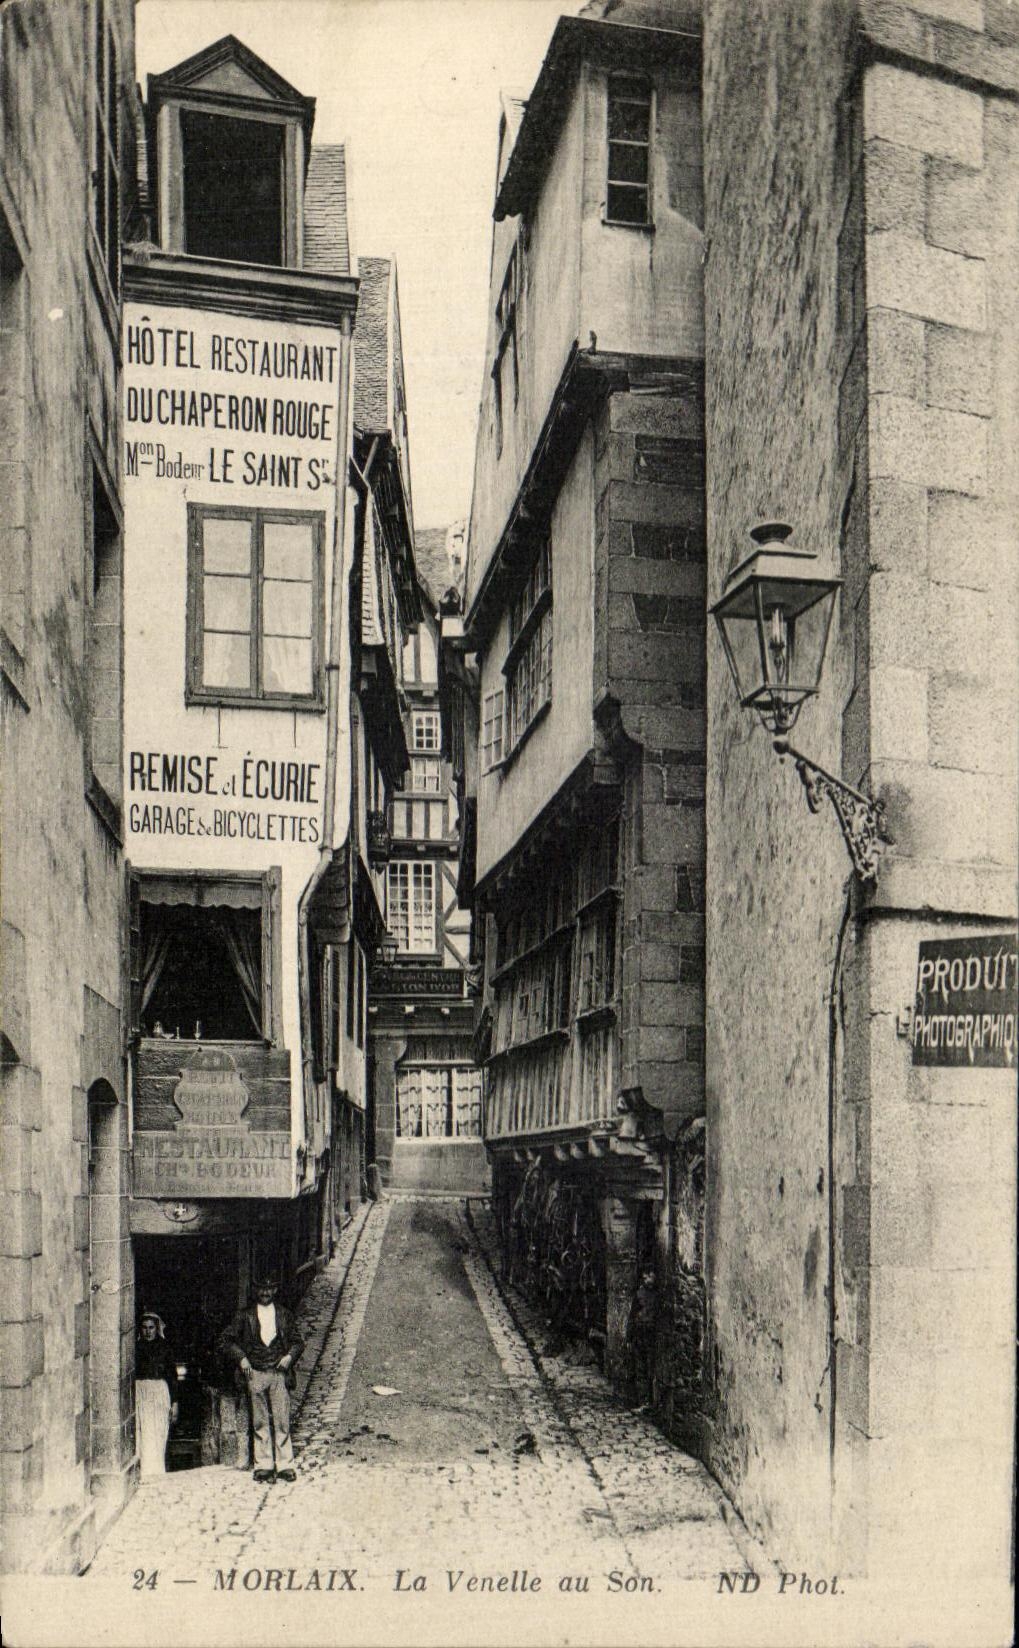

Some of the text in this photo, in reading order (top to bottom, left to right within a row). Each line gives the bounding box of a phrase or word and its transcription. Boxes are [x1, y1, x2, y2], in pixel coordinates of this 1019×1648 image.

[128, 316, 338, 383] HÔTEL RESTAURANT
[127, 386, 334, 441] DU CHAPERON ROUGE
[208, 446, 235, 484] LE
[242, 451, 303, 489] SAINT
[129, 751, 219, 796] REMISE
[242, 750, 321, 804] ÉCURIE
[129, 803, 196, 836] GARAGE
[213, 808, 320, 844] BICYCLETTES
